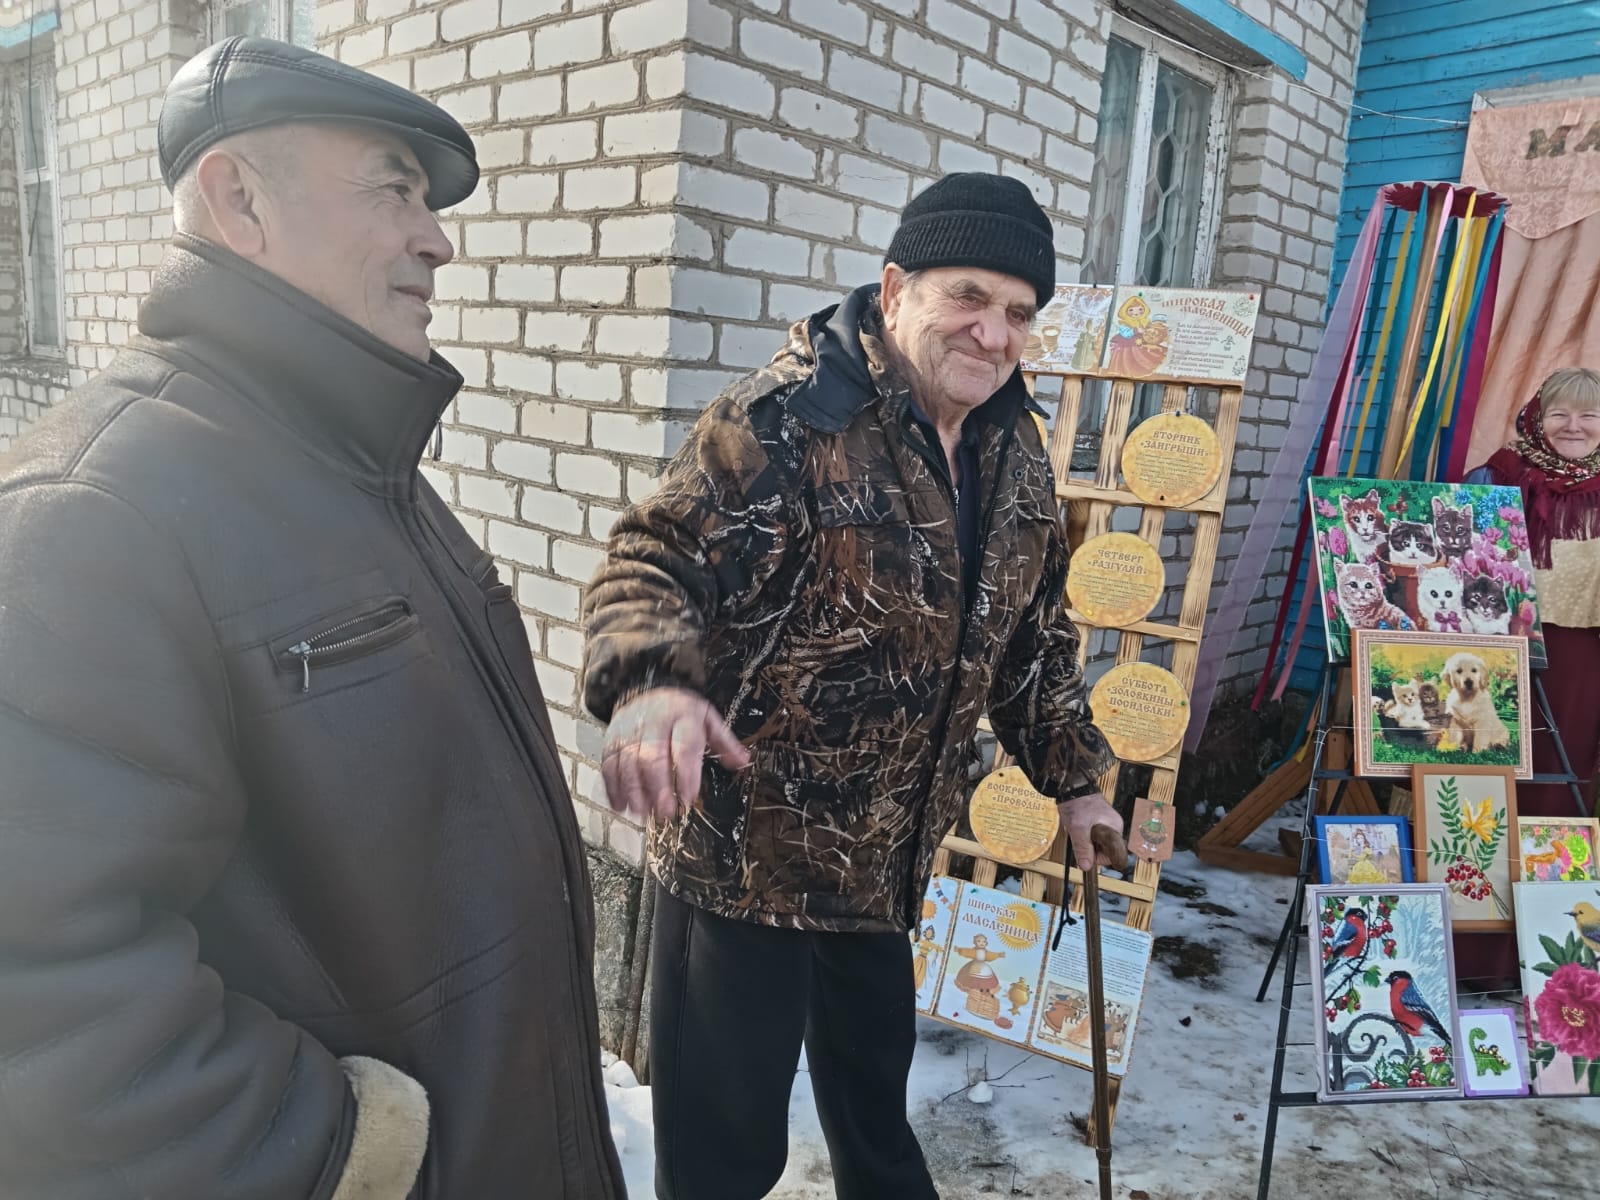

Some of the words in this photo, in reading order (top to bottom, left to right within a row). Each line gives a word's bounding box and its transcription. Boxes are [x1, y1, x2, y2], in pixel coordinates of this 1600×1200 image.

[1161, 297, 1226, 312] ШИРОКАЯ
[1153, 430, 1201, 445] ВТОРНИК
[1098, 549, 1144, 563] ЧЕТВЕРГ
[1122, 677, 1168, 694] СУББОТА
[967, 898, 1016, 920] ШИРОКАЯ
[962, 912, 1040, 943] МАСЛЕНИЦА
